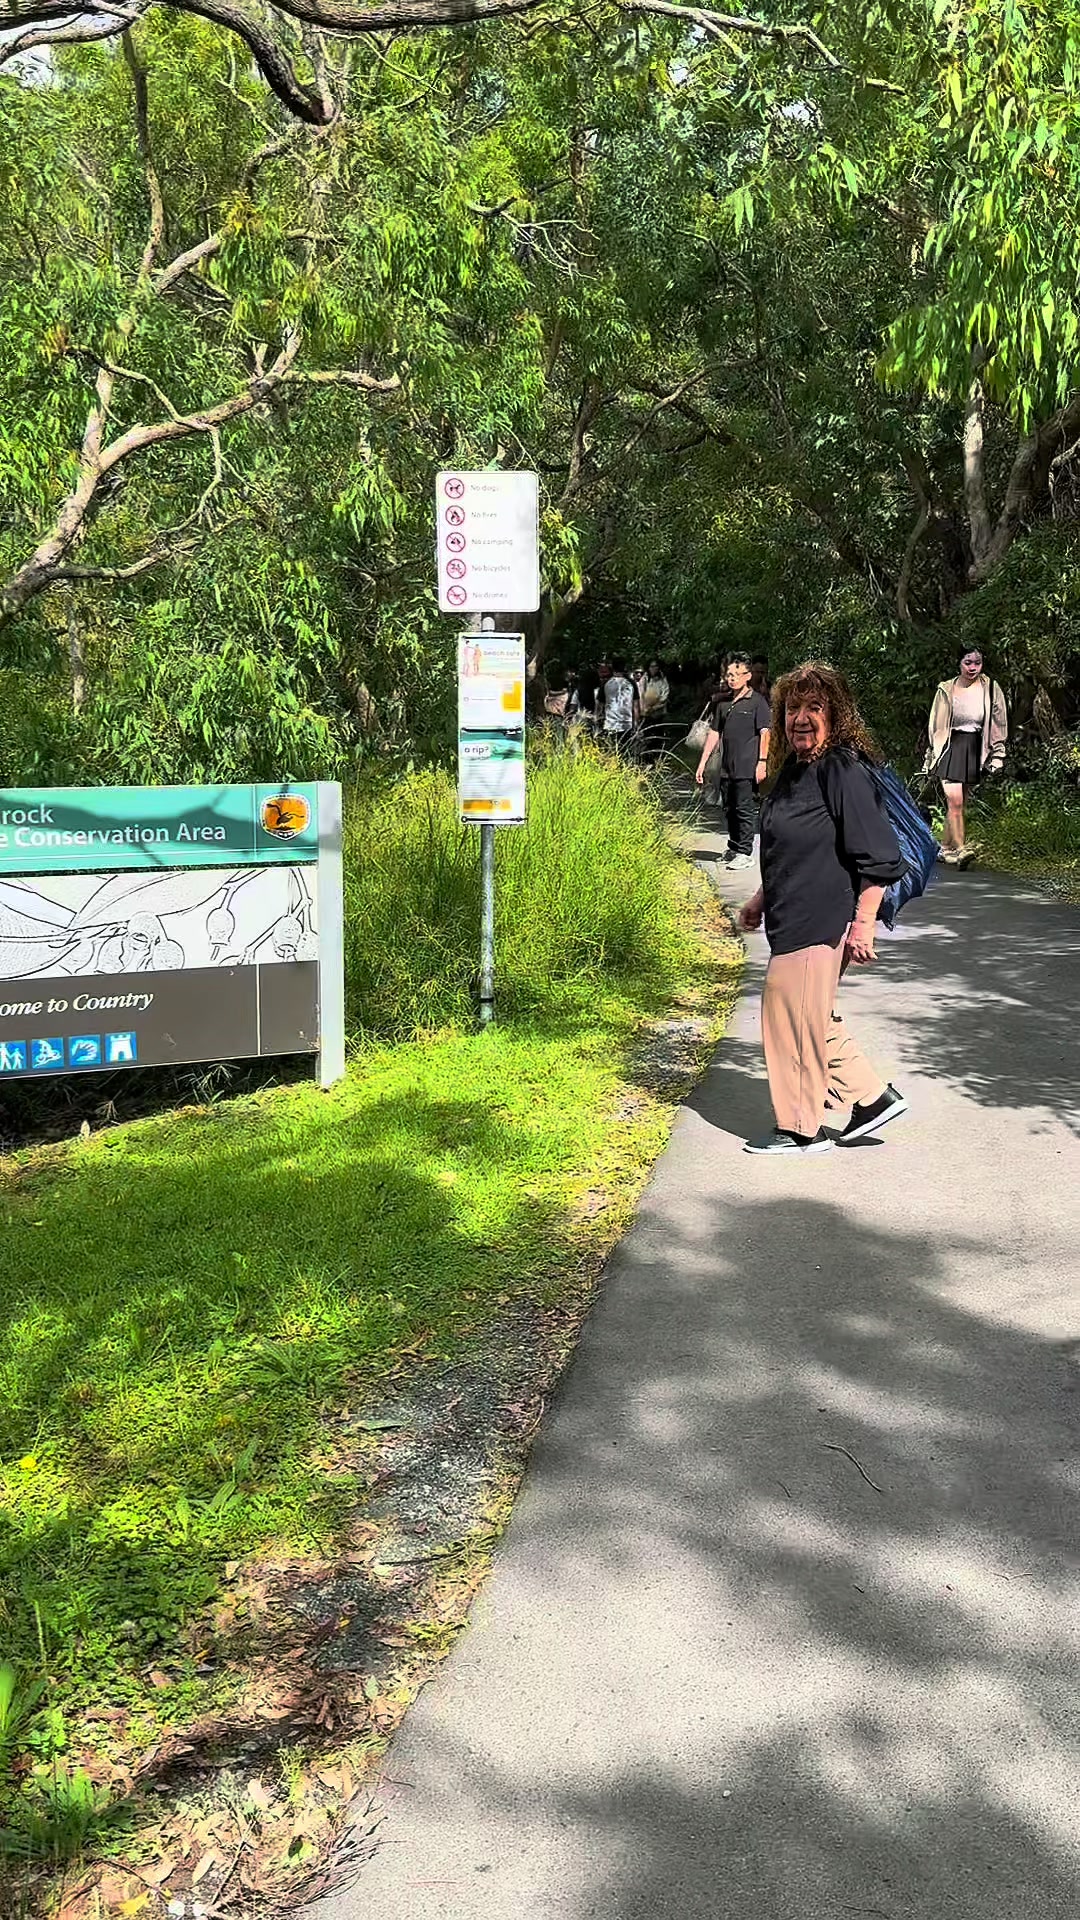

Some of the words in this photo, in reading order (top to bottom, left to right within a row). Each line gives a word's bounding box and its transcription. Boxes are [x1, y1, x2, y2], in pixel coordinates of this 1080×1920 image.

[482, 538, 513, 546] camping
[472, 746, 489, 755] rip?
[2, 803, 55, 825] rock
[15, 824, 170, 847] Conservation
[176, 823, 226, 841] Area
[0, 1001, 43, 1017] ome
[47, 998, 68, 1013] to
[73, 992, 154, 1011] Country
